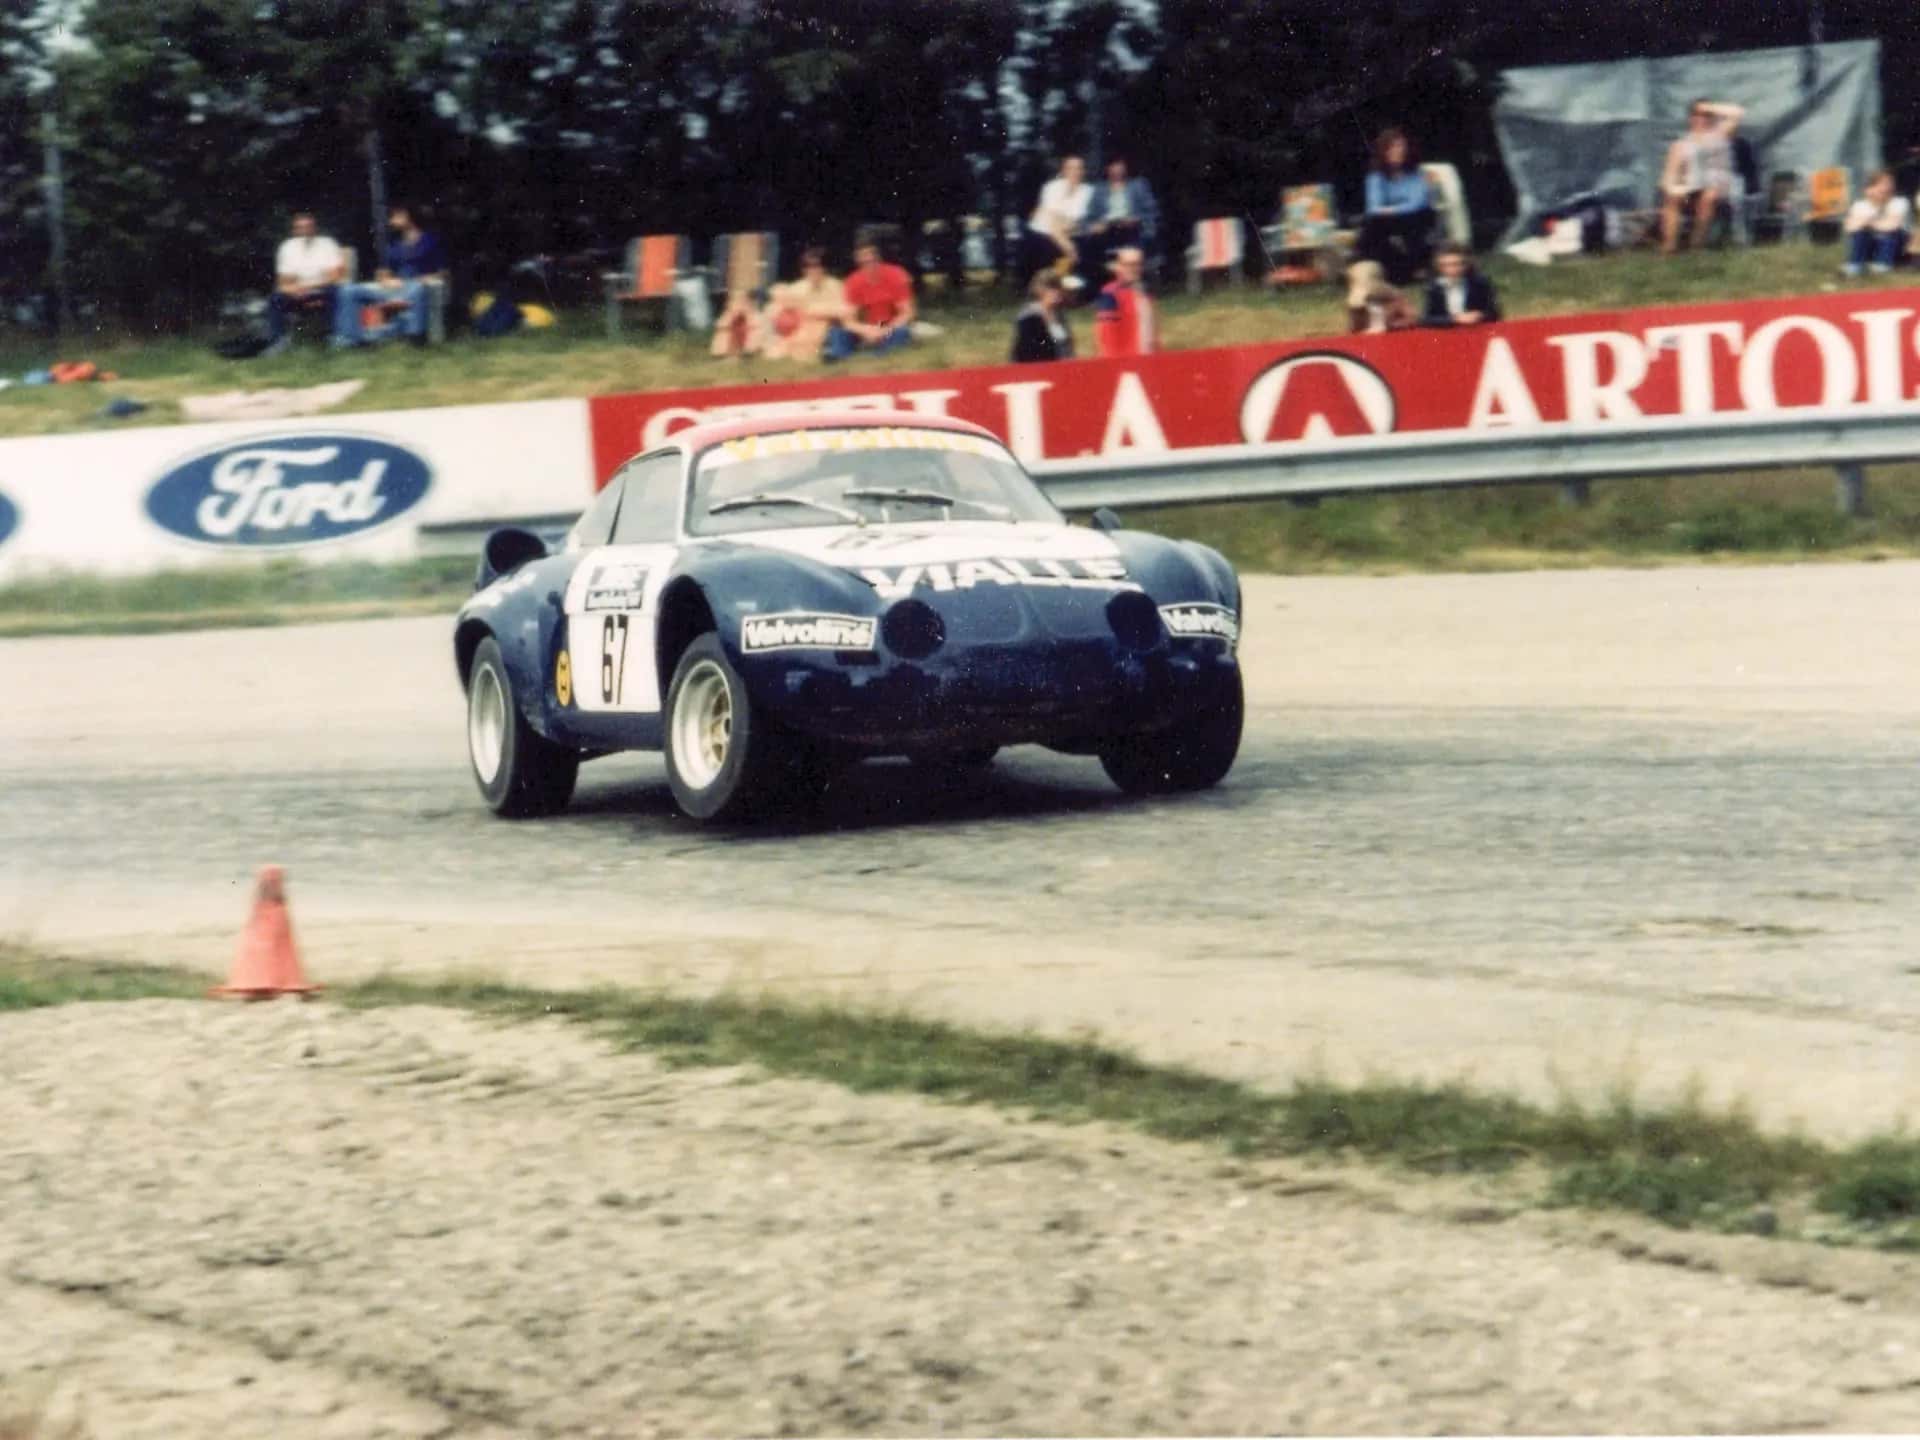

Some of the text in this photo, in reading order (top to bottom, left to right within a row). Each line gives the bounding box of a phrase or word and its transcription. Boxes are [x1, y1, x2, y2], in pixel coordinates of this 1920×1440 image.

[1468, 308, 1920, 429] ARTOI
[197, 446, 388, 536] Ford
[859, 556, 1144, 598] VIALLE
[601, 614, 629, 705] 67
[746, 617, 871, 648] Valvoline
